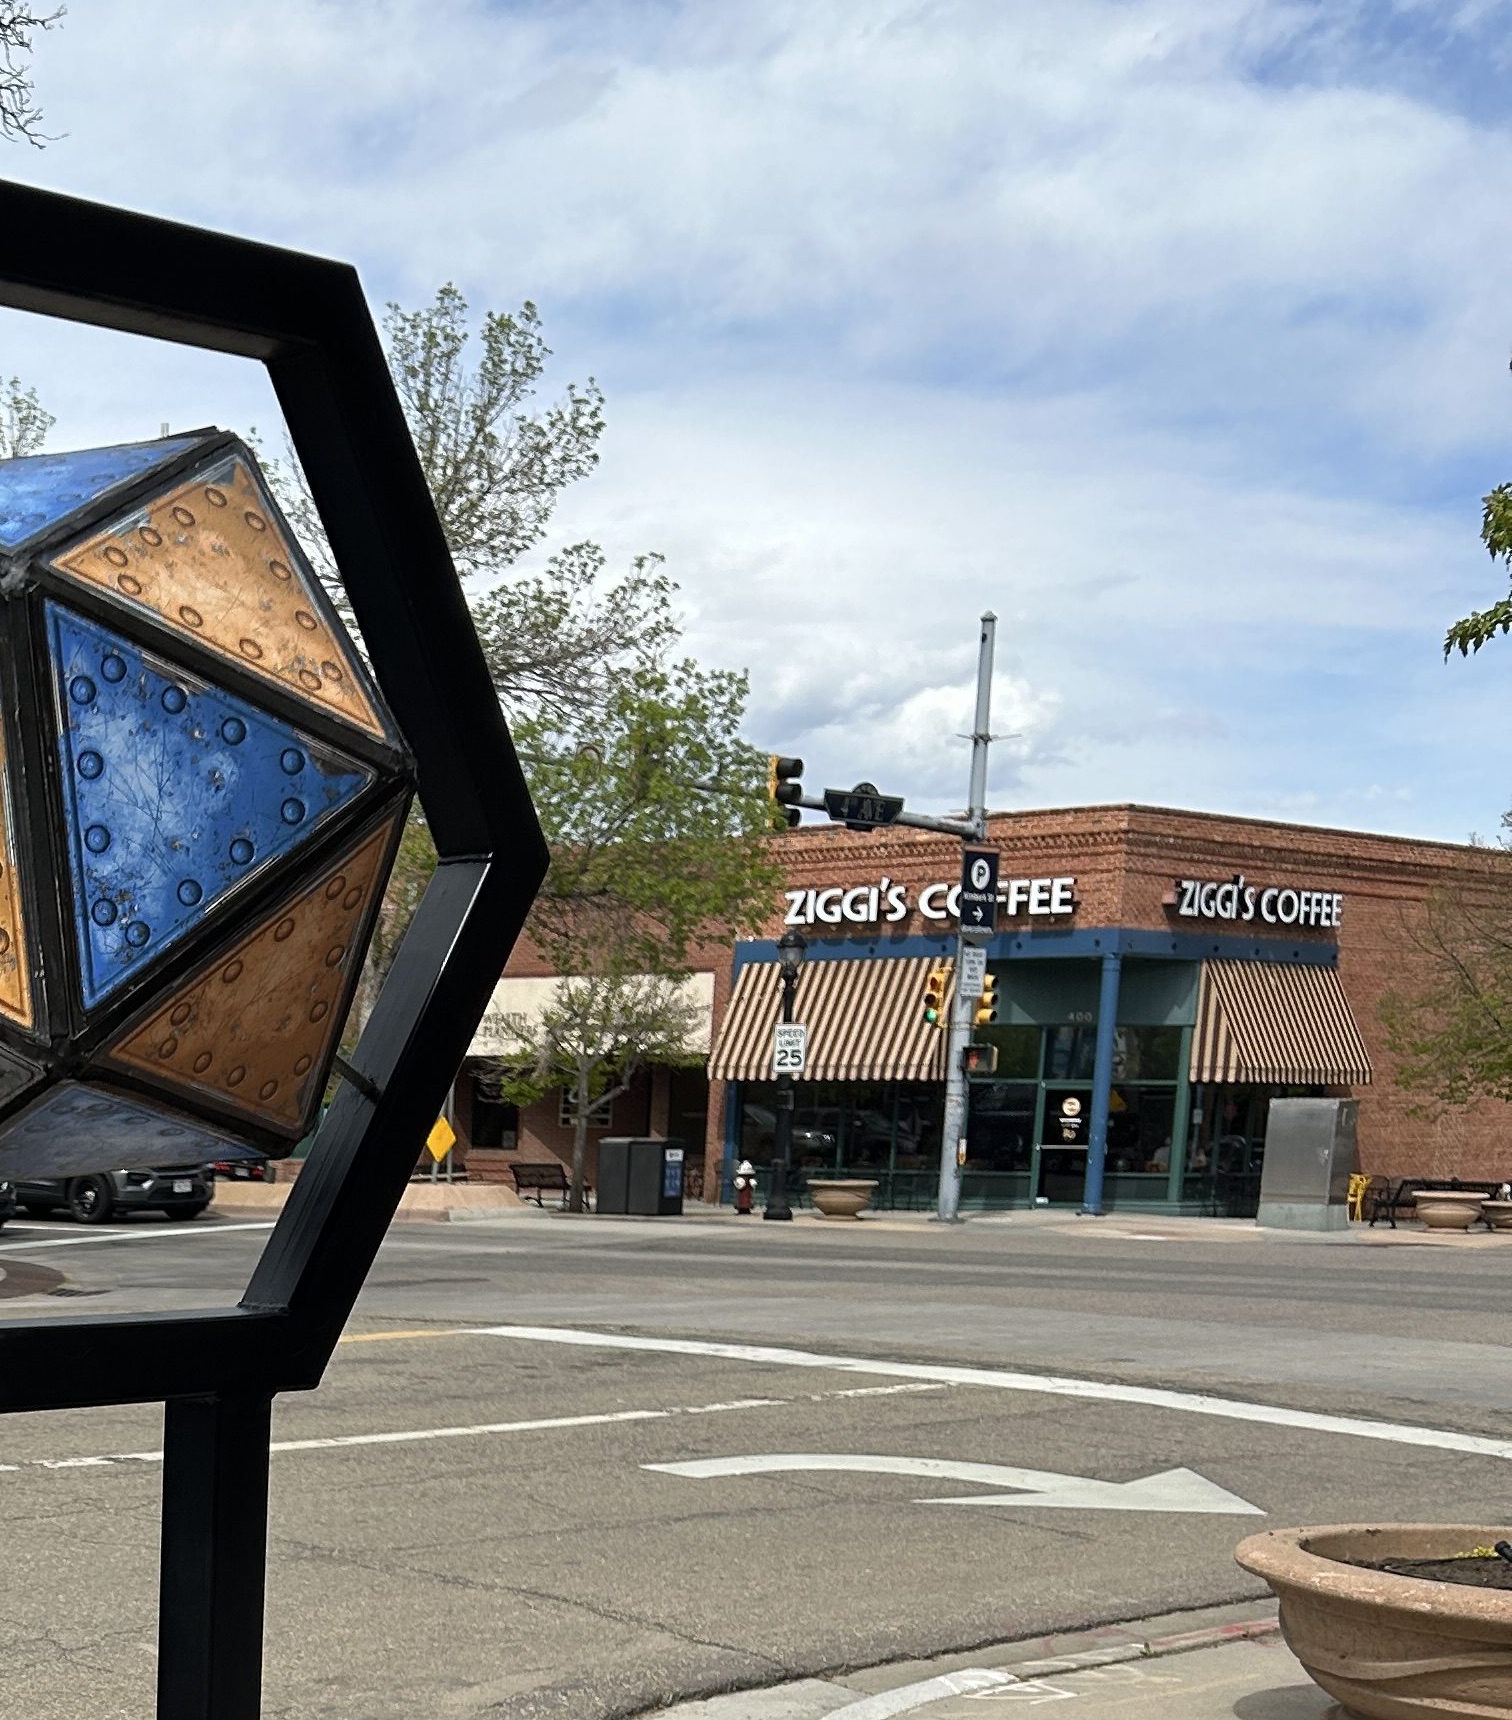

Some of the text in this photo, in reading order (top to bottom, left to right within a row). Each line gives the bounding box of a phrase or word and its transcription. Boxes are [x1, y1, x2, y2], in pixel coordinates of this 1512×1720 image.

[784, 876, 907, 925] ZIGGI'S
[1178, 875, 1343, 927] ZIGGI'S COFFEE
[777, 1028, 805, 1038] SPEED
[778, 1039, 802, 1048] LIMIT
[777, 1049, 803, 1067] 25
